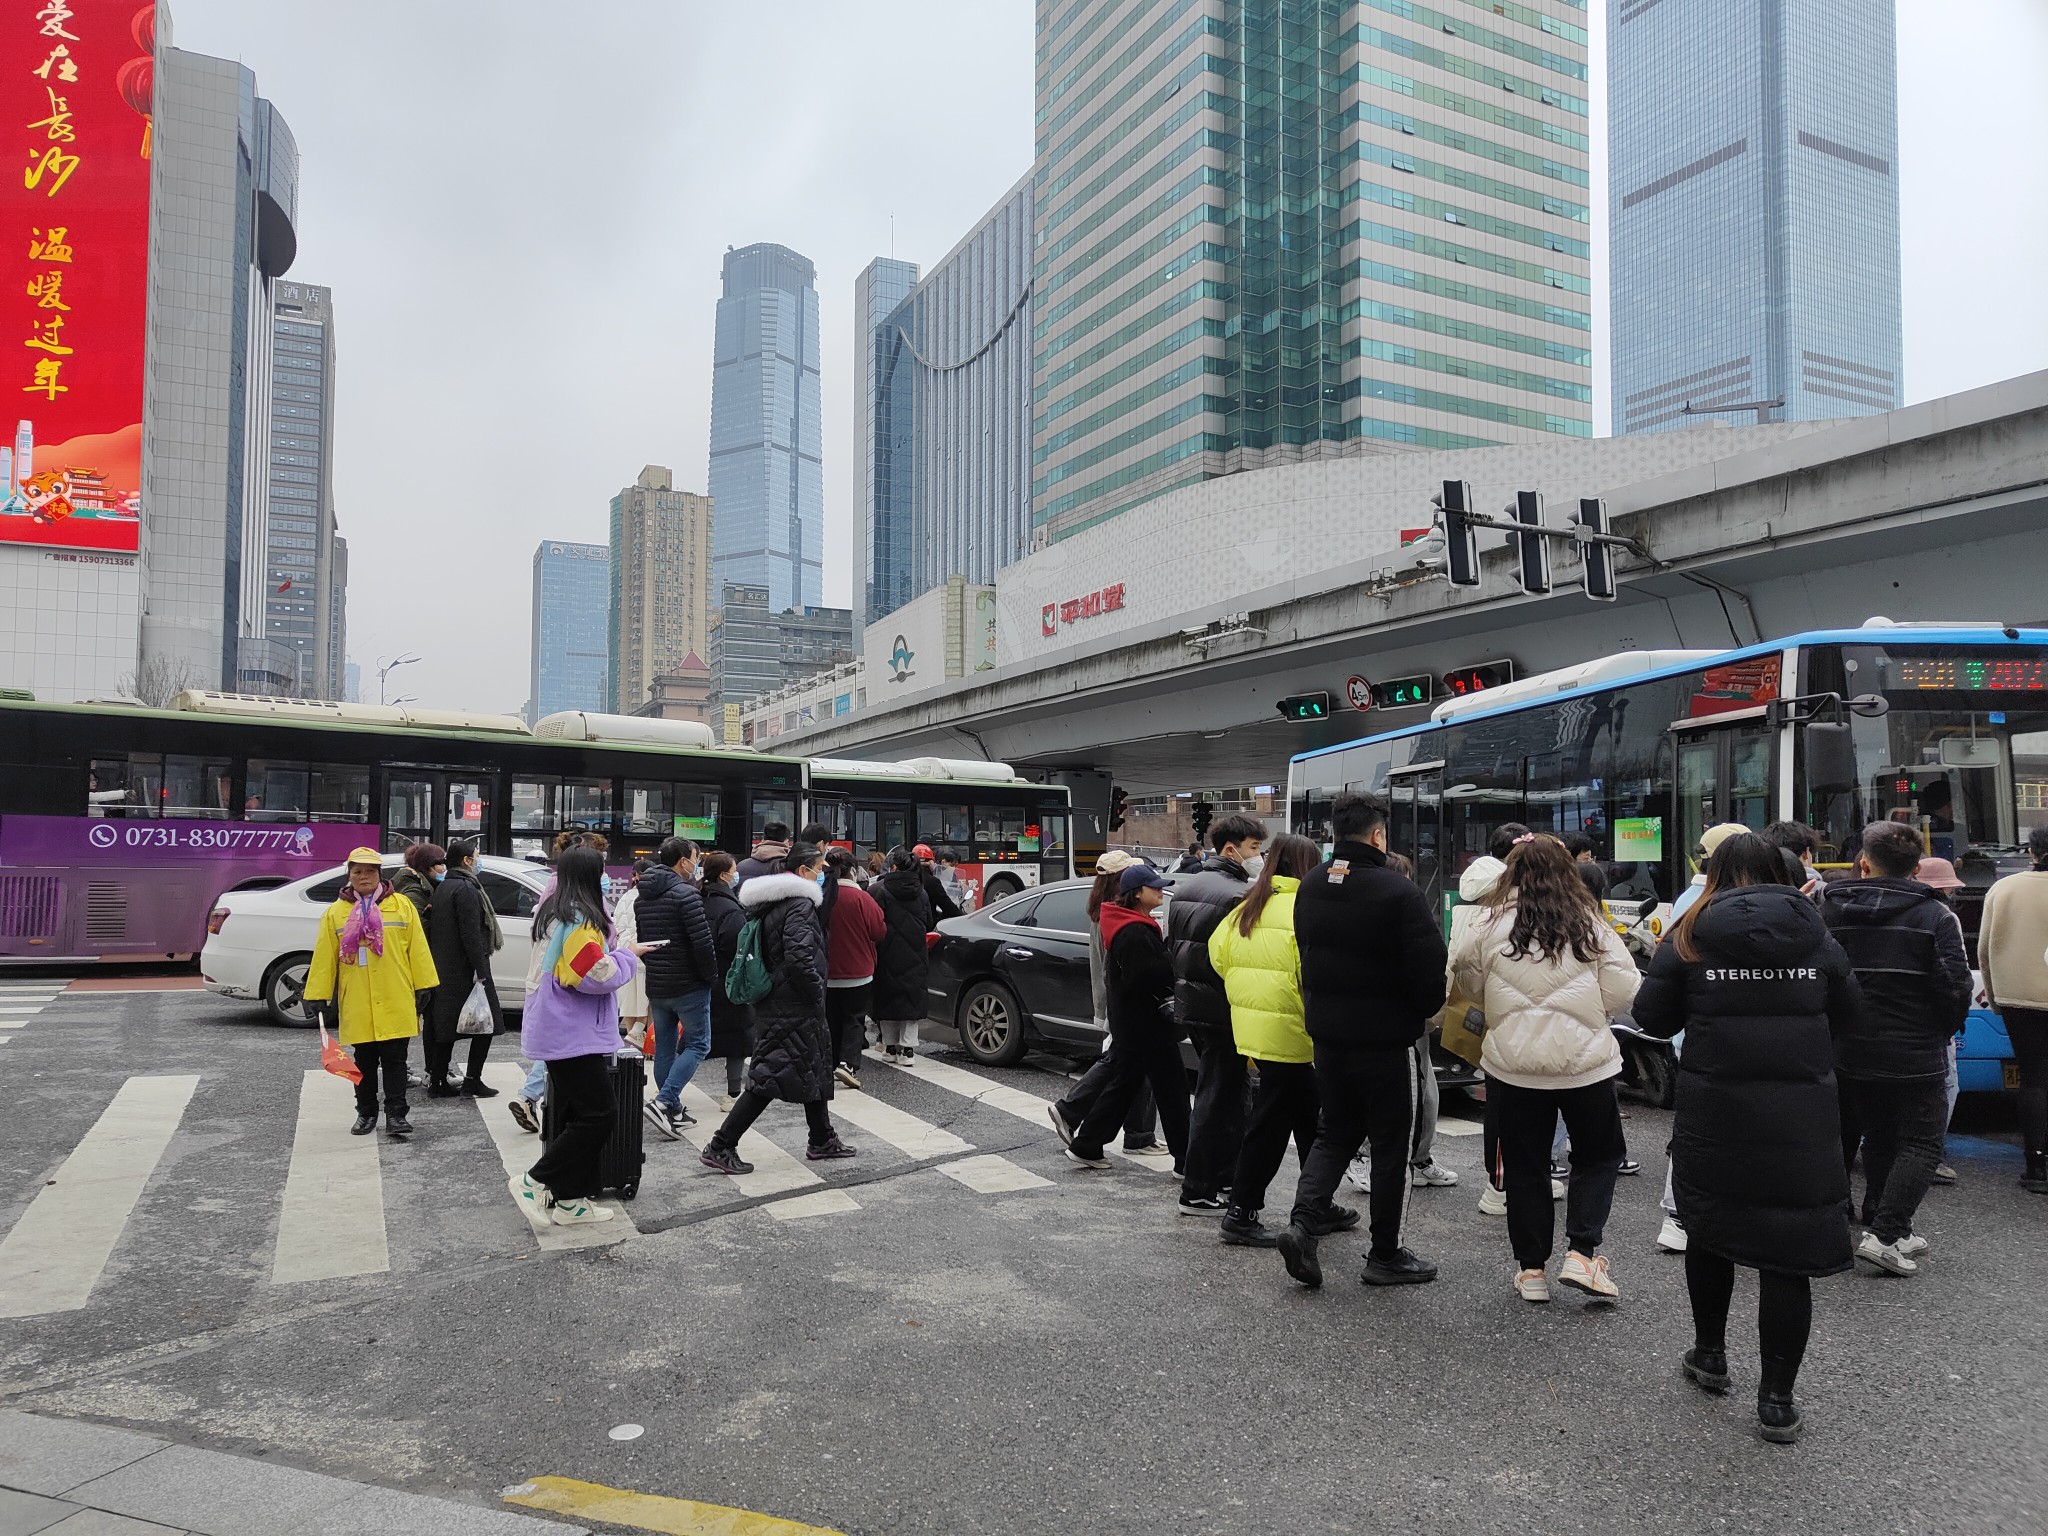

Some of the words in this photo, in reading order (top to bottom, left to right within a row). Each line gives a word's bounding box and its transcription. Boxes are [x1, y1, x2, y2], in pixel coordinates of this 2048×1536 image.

[283, 284, 320, 303] 酒店
[22, 227, 74, 400] 温暖过年
[45, 553, 77, 563] 广告招商
[79, 555, 135, 567] 15907313366
[1060, 583, 1125, 624] 平和堂
[125, 827, 297, 848] 0731-83077777
[1705, 968, 1817, 980] STEREOTYPE
